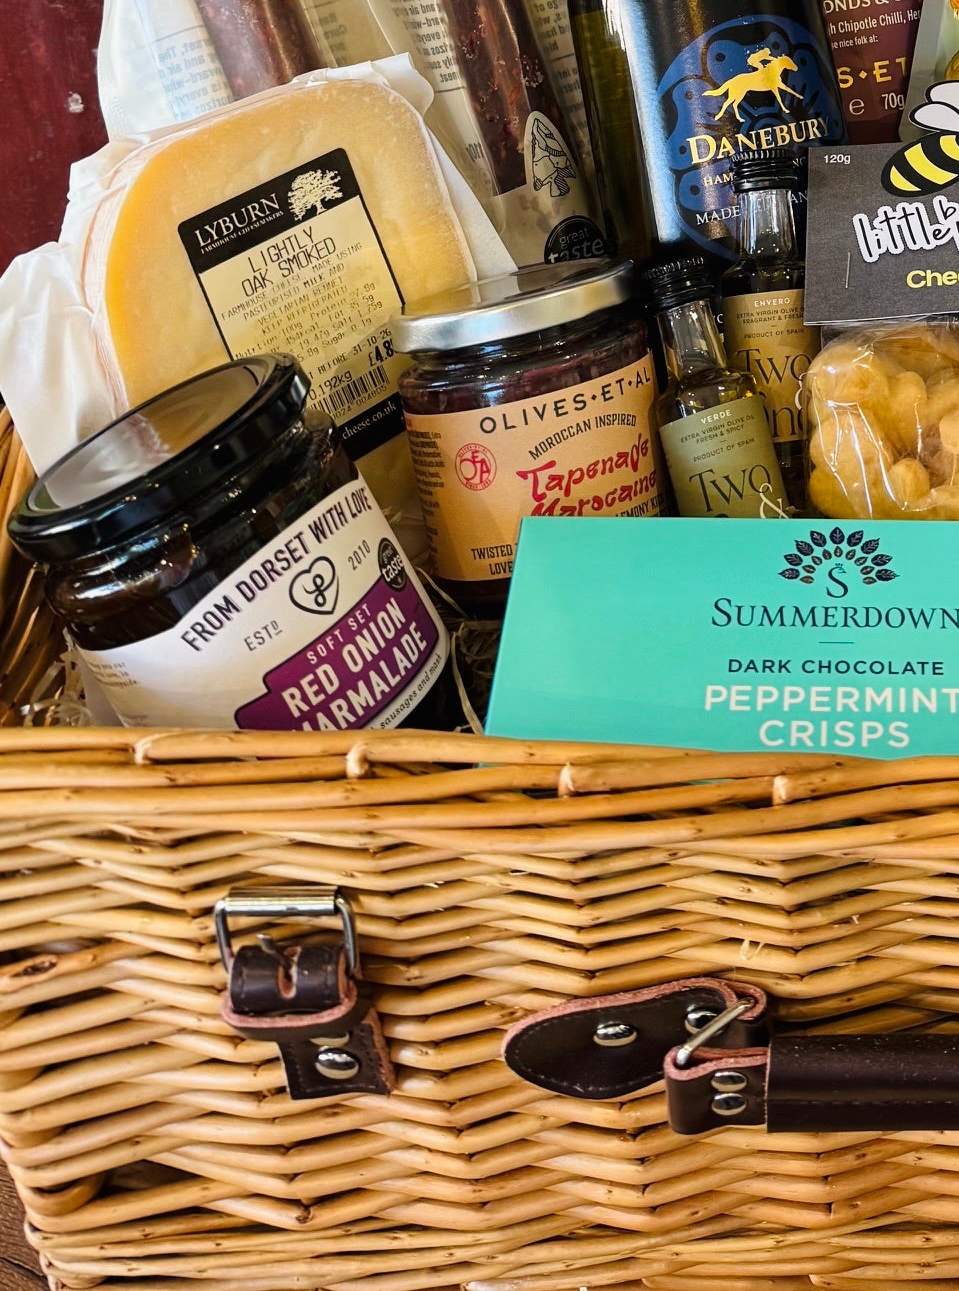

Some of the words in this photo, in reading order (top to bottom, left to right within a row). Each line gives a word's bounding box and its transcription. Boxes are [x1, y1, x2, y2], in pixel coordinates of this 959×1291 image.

[687, 117, 830, 164] DANEBURY
[824, 154, 851, 164] 120g
[194, 193, 280, 247] LYBURN
[862, 206, 951, 259] little
[242, 271, 274, 298] OAK
[279, 236, 336, 279] SMOKED
[248, 226, 314, 273] LIGHTLY
[754, 297, 791, 308] ENVERO
[528, 418, 592, 461] MOROCCAN
[595, 412, 637, 429] INSPIRED
[680, 432, 700, 444] EXTRA
[702, 424, 725, 438] VIRGIN
[726, 417, 744, 430] OLIVE
[746, 414, 755, 422] OIL
[700, 409, 732, 424] VERDE
[517, 433, 649, 502] Tapenade
[180, 594, 241, 652] FROM
[236, 530, 311, 602] DORSET
[308, 504, 350, 544] WITH
[346, 488, 372, 520] LOVE
[348, 540, 371, 571] 2010
[471, 543, 513, 560] TWISTED
[281, 664, 341, 718] RED
[342, 597, 406, 673] ONION
[306, 628, 346, 665] SOFT
[350, 603, 371, 630] SET
[728, 659, 792, 674] DARK
[801, 659, 945, 676] CHOCOLATE
[759, 719, 911, 749] CRISPS
